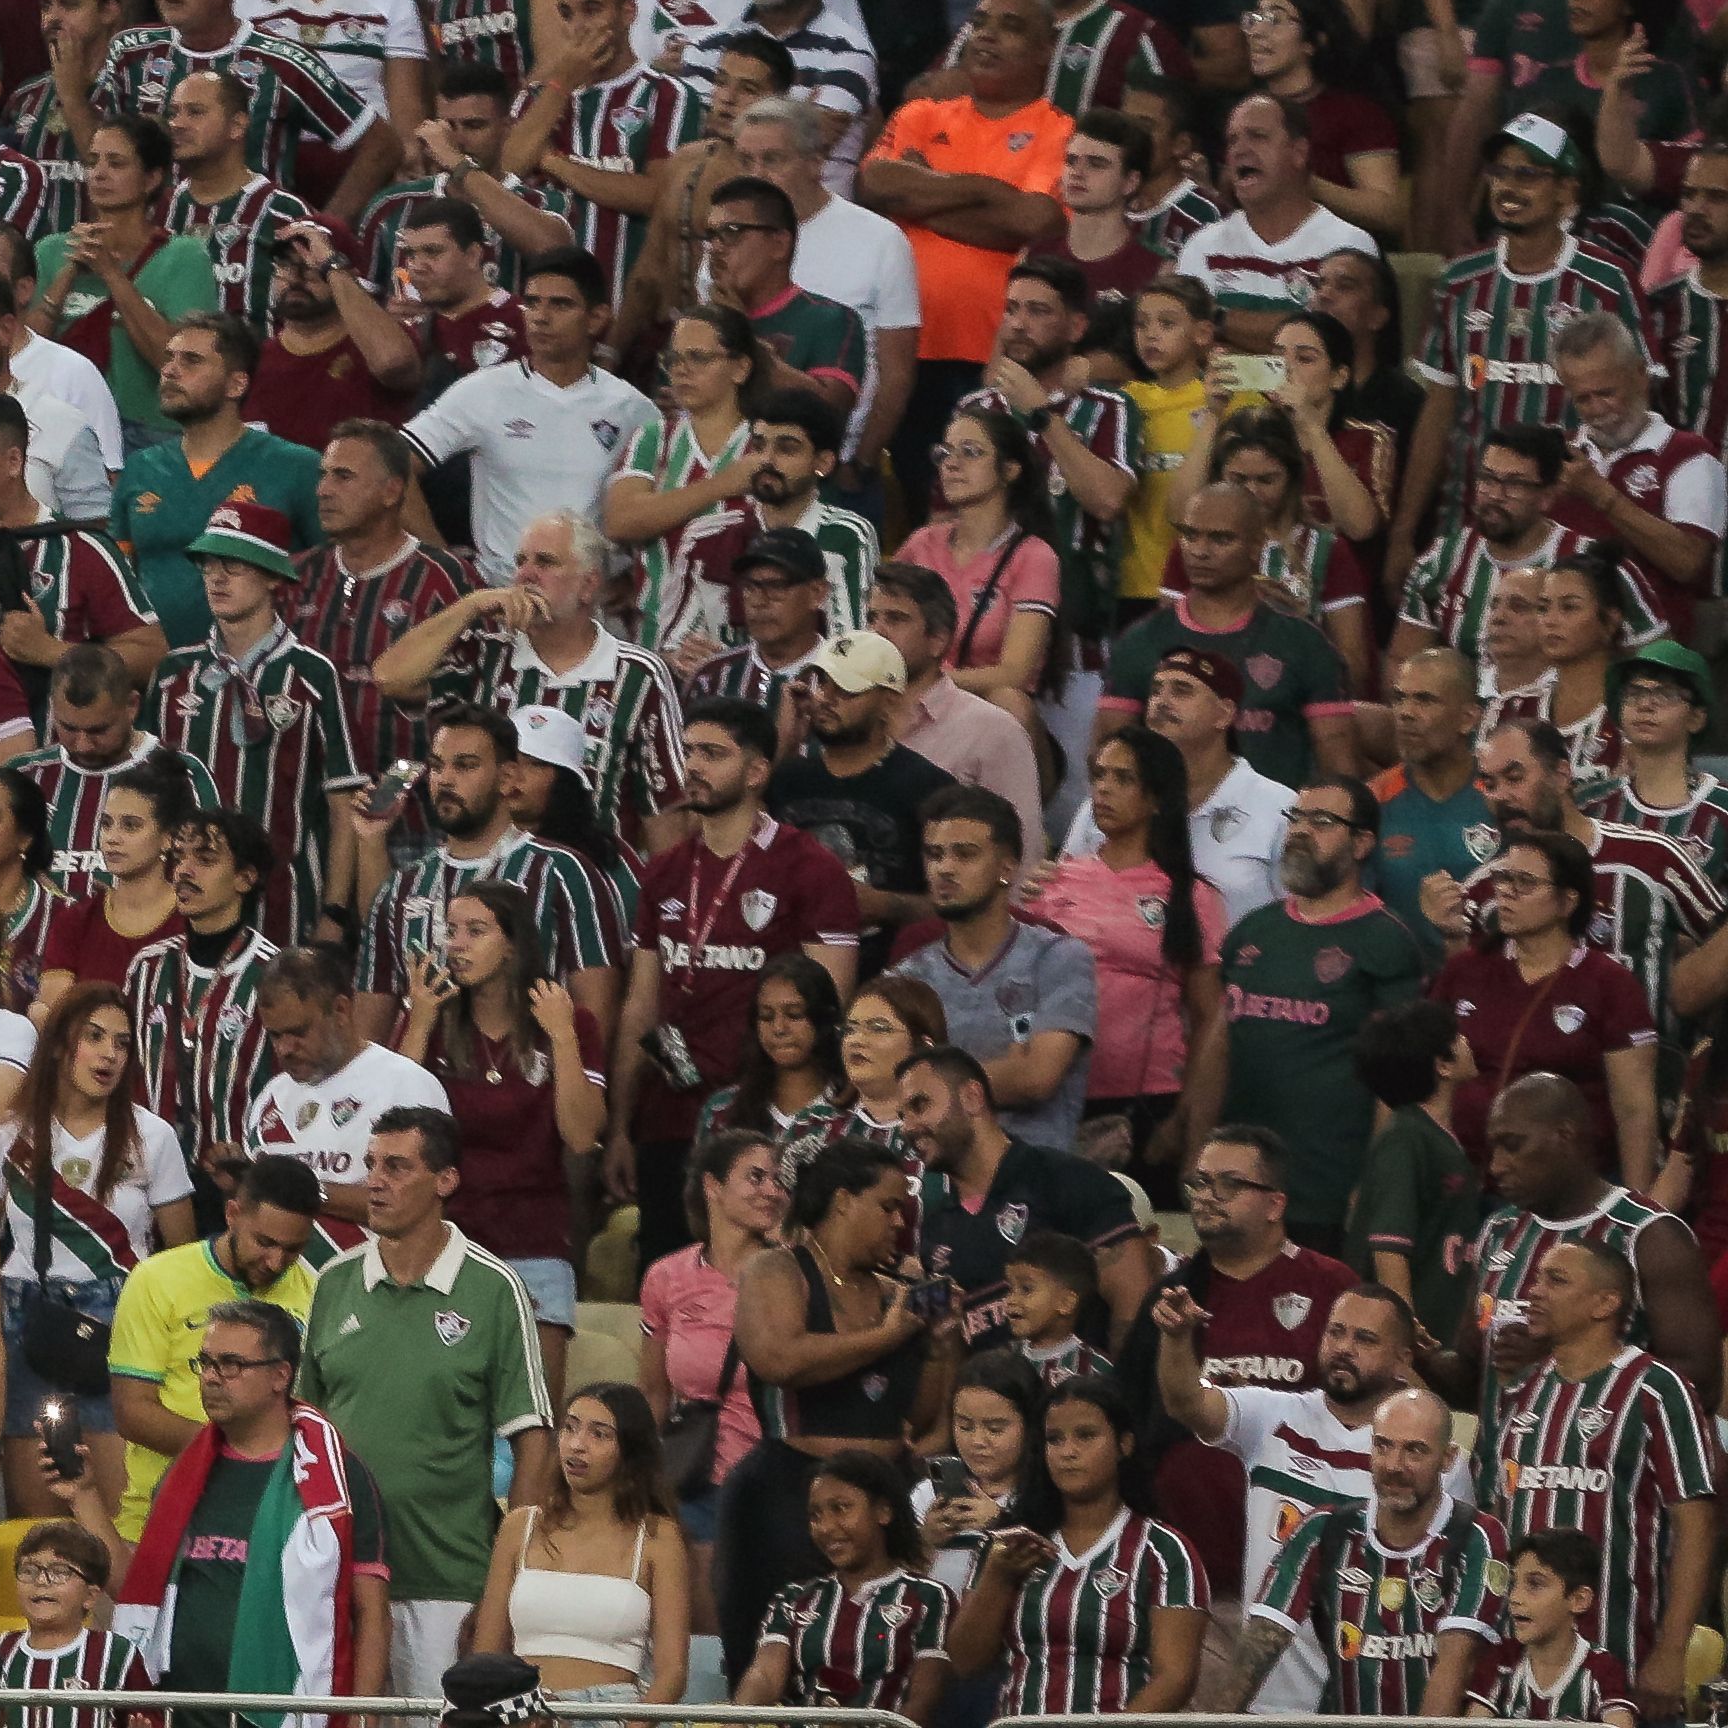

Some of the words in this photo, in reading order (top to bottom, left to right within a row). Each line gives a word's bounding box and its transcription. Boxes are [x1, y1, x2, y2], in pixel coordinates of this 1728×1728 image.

[52, 850, 110, 873] BETA
[672, 943, 767, 970] BTANO
[1517, 1466, 1607, 1492] BETANO
[1361, 1633, 1437, 1660] BETAN
